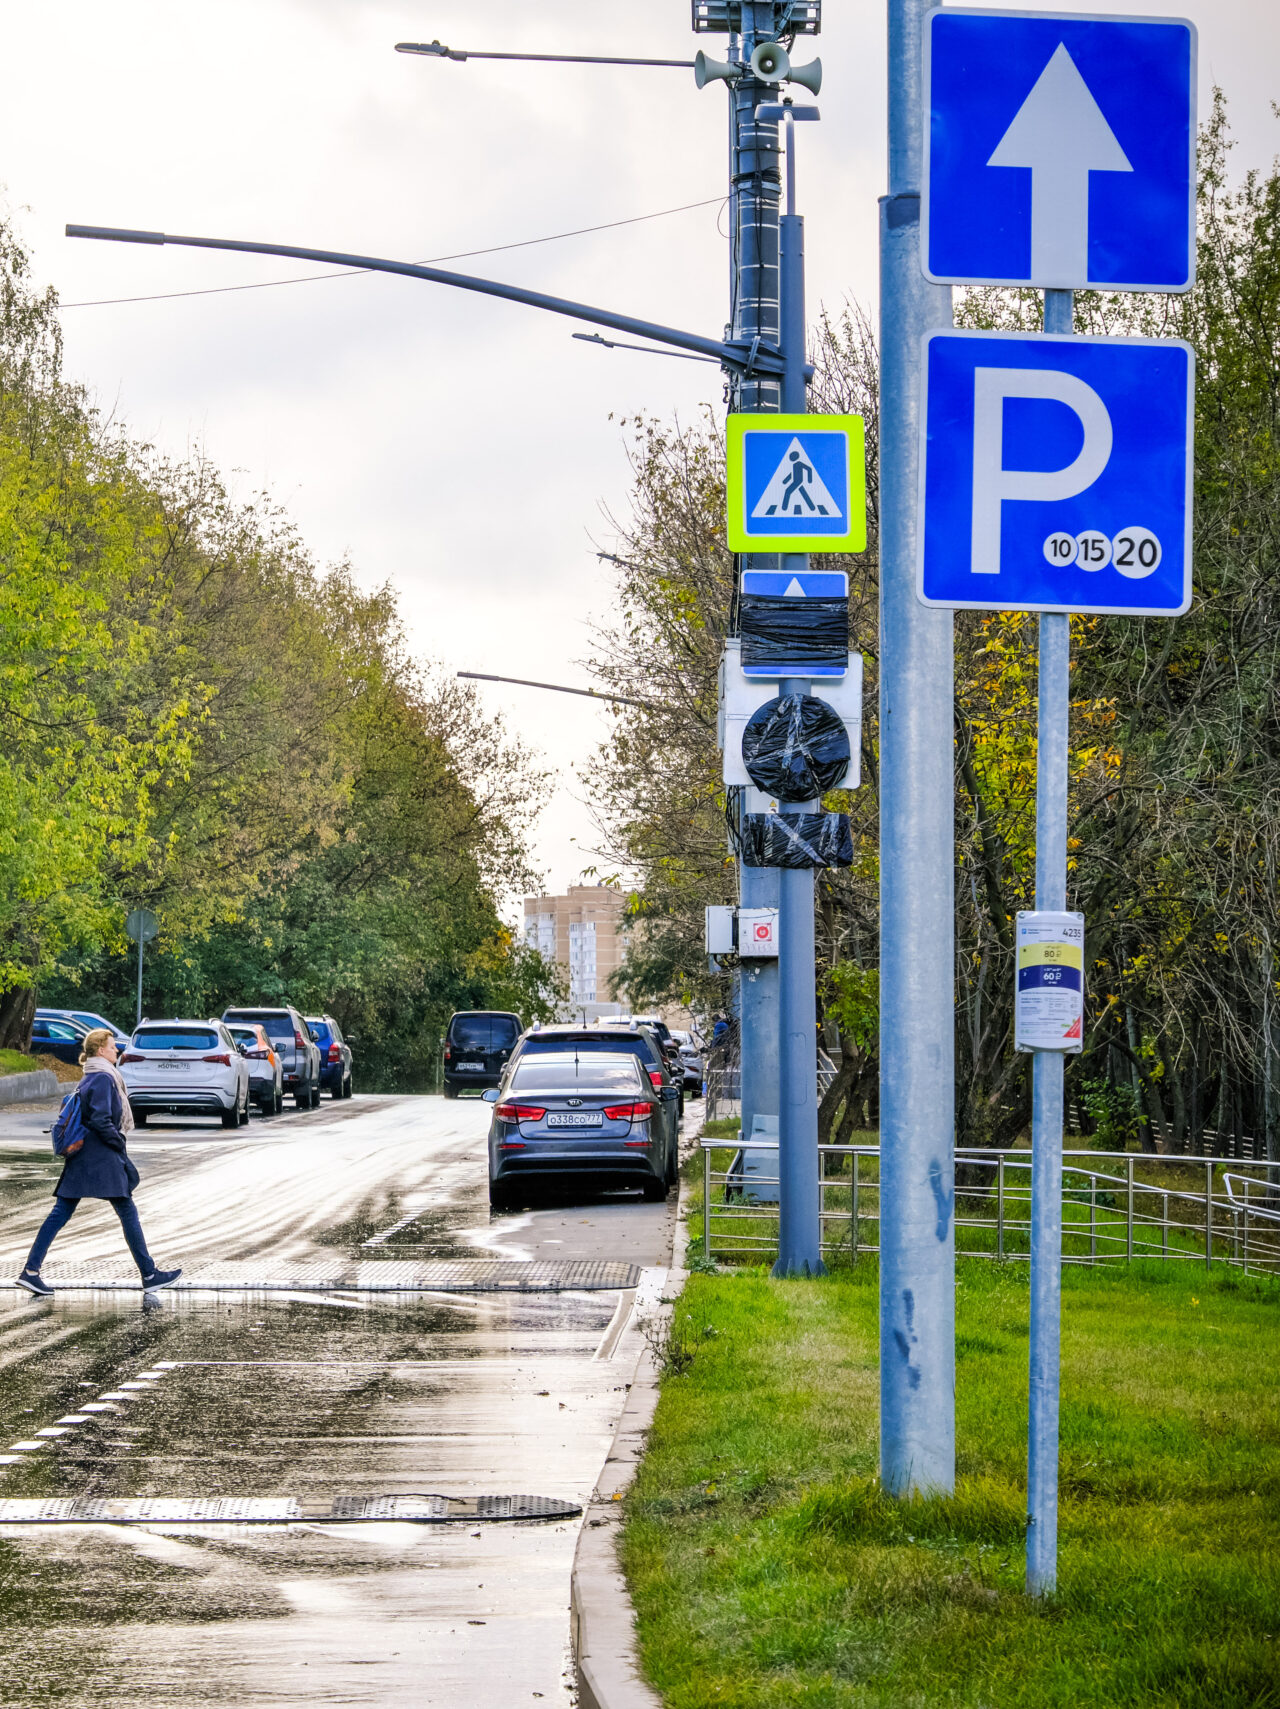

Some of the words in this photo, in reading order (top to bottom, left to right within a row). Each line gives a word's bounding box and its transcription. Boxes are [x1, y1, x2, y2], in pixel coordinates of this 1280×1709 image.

[971, 366, 1113, 574] P
[1050, 539, 1072, 558] 10
[1080, 538, 1106, 562] 15
[1116, 537, 1158, 568] 20
[1062, 928, 1082, 938] 4235
[1043, 972, 1055, 981] 60
